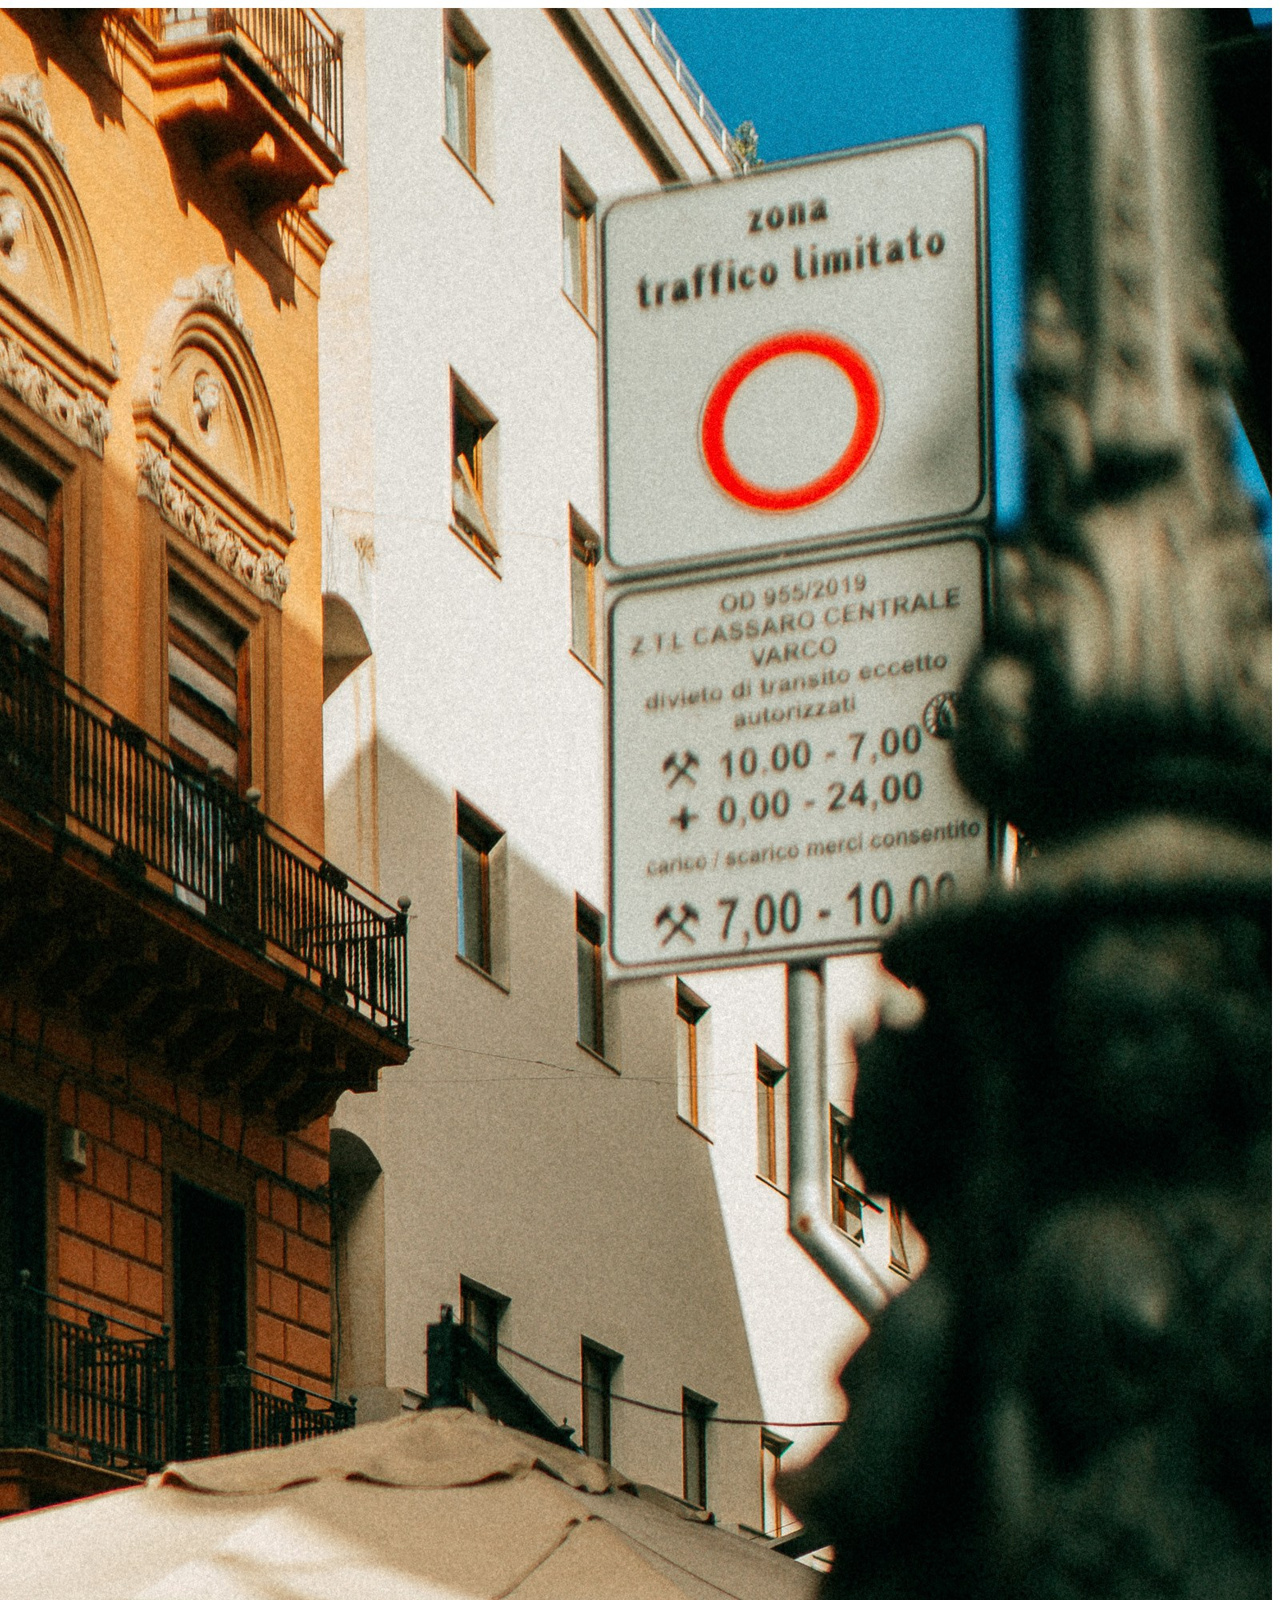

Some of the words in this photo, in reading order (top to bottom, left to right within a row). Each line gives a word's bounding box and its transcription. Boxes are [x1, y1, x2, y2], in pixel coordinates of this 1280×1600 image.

[747, 198, 828, 233] zona
[637, 258, 778, 308] traffico
[793, 226, 945, 280] limitato
[693, 612, 814, 645] CASSARO
[823, 587, 961, 626] CENTRALE
[720, 592, 754, 613] OD
[763, 574, 867, 606] 955/2019
[751, 637, 836, 667] VARCO
[645, 687, 722, 710] divieto
[731, 679, 751, 698] di
[760, 667, 850, 695] transito
[858, 653, 947, 679] eccetto
[733, 695, 856, 729] autorizzati
[718, 790, 789, 829] 0,00
[827, 771, 922, 813] 24,00
[645, 856, 706, 877] carico
[725, 845, 800, 868] scarico
[806, 833, 862, 857] merci
[869, 820, 981, 850] consentito
